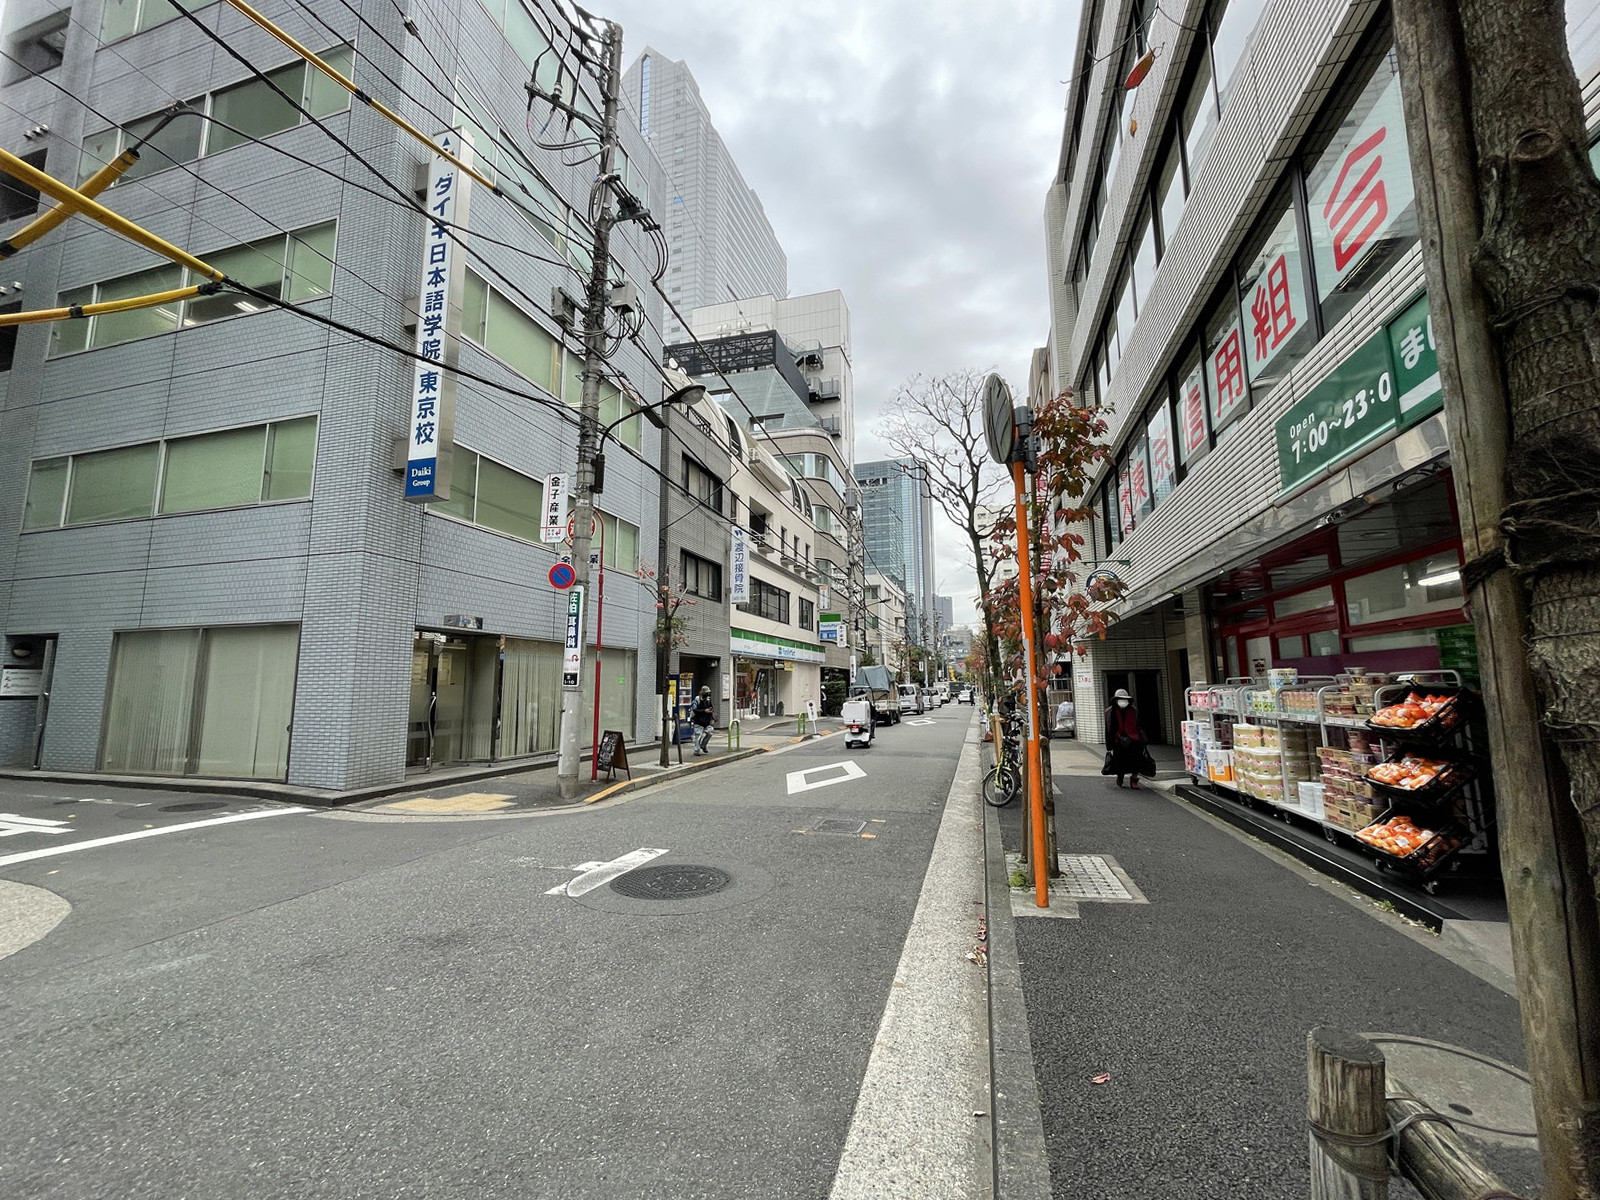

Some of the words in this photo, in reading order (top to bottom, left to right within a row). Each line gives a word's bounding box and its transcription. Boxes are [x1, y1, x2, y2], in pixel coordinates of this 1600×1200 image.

[1289, 412, 1315, 439] Open
[411, 467, 432, 478] Daiki
[412, 479, 430, 487] Group
[548, 476, 561, 526] 金子産業
